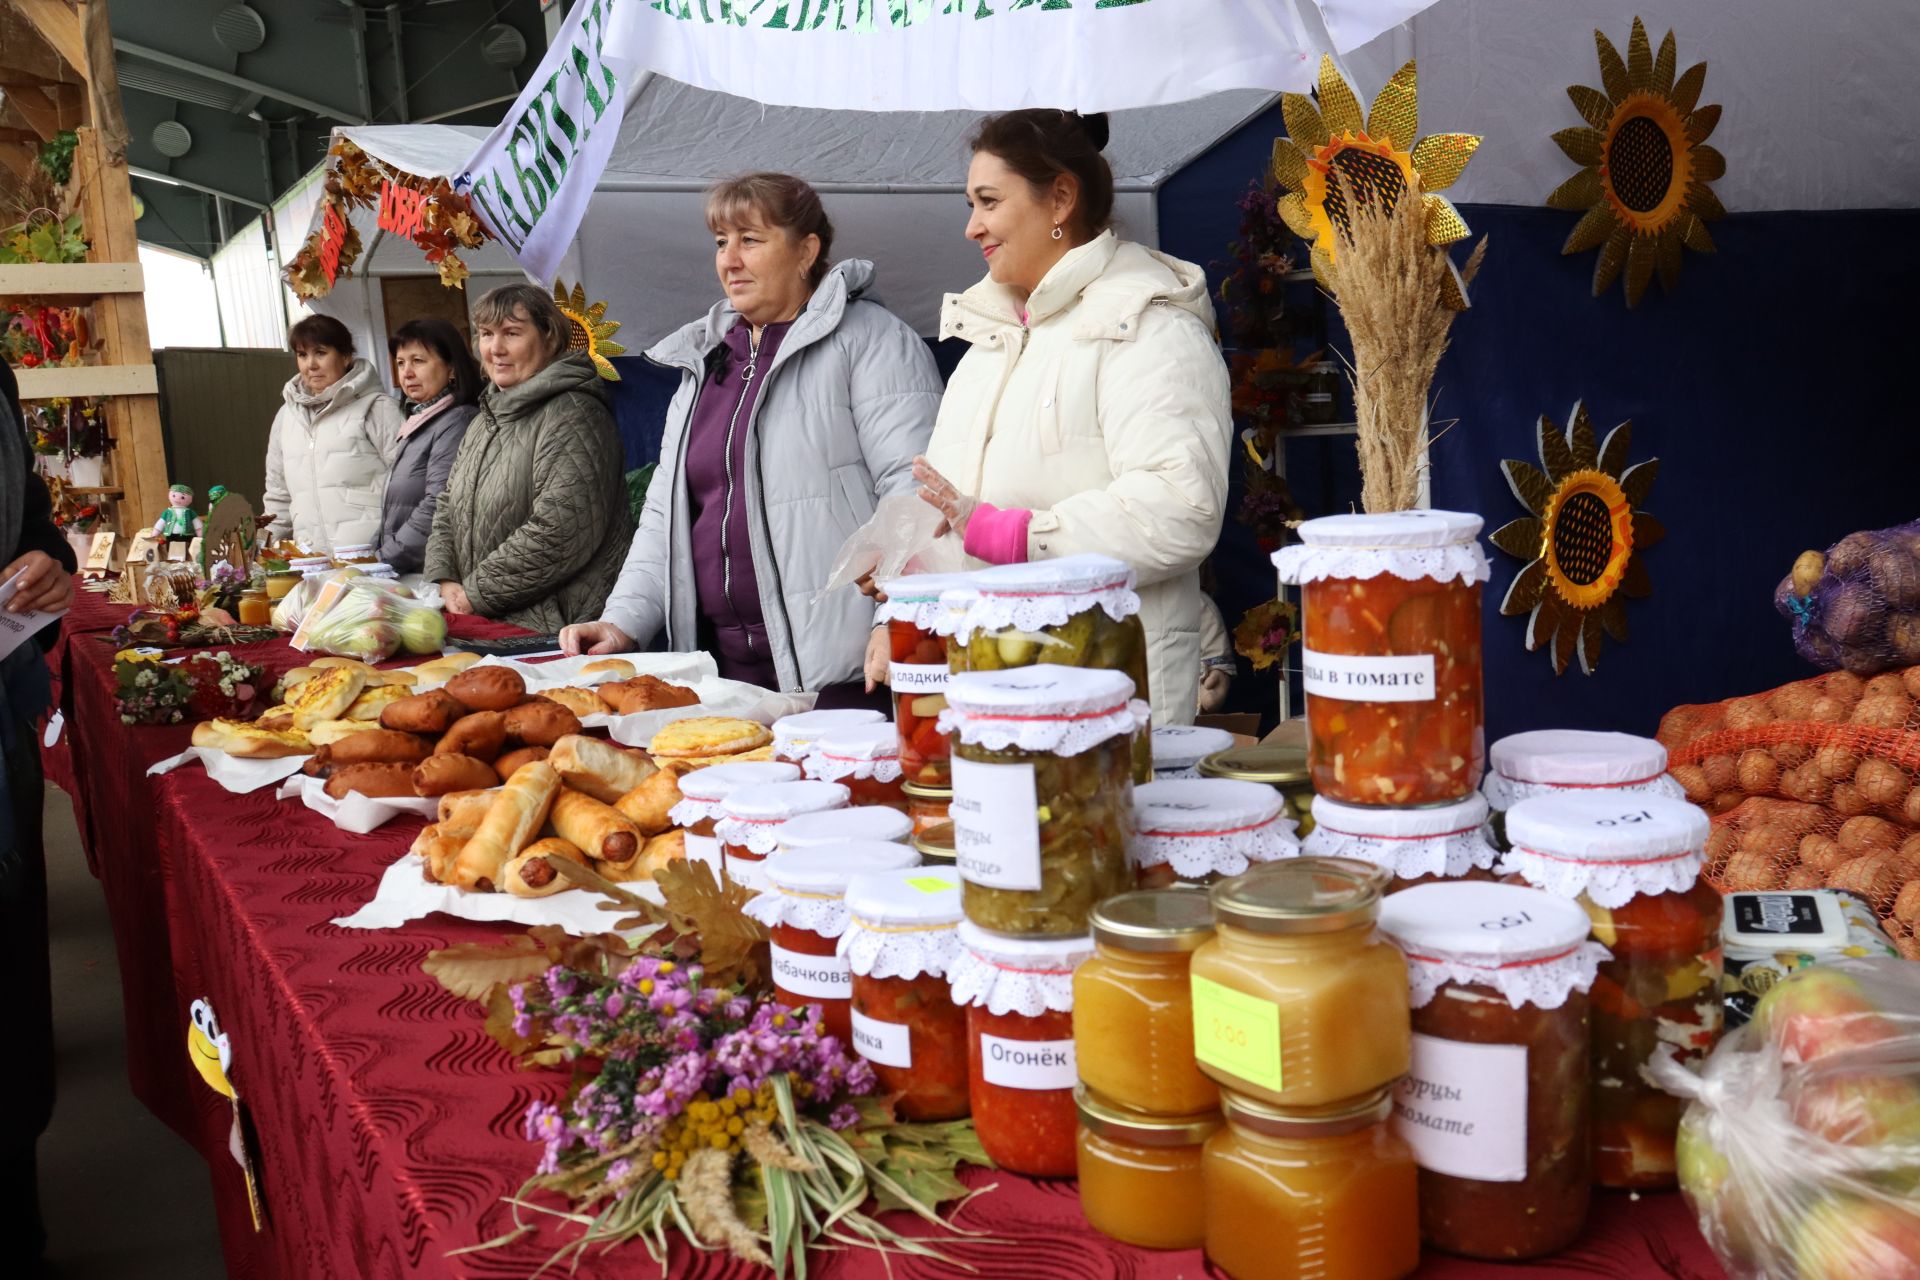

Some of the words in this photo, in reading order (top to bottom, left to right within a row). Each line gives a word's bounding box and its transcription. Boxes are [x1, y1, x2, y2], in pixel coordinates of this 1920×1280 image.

[896, 672, 950, 686] сладкие
[1328, 670, 1339, 683] в
[1344, 671, 1424, 686] томате
[1596, 810, 1653, 827] 150
[1480, 911, 1533, 929] 150
[991, 1043, 1067, 1067] Огонёк
[1401, 1076, 1463, 1101] урцы
